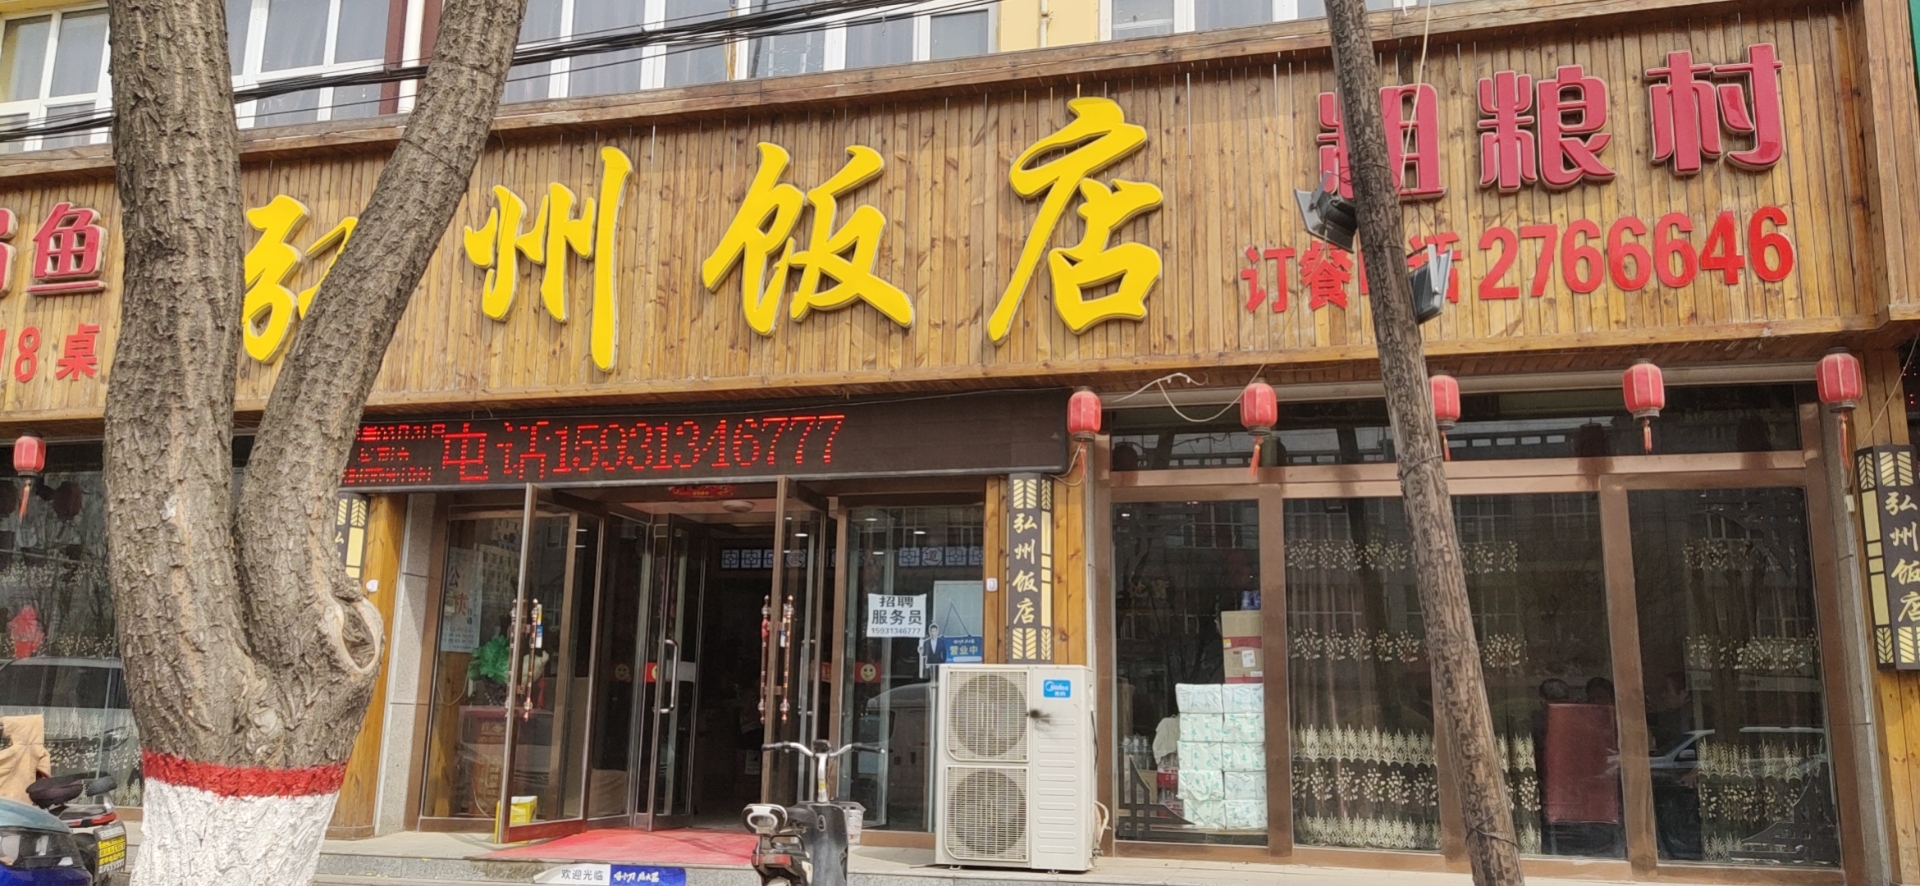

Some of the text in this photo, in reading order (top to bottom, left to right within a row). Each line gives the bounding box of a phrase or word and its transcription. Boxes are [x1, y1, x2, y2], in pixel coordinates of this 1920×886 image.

[1316, 42, 1784, 201] 粗粮村
[243, 96, 1164, 373] 弘州饭店
[1479, 205, 1794, 301] 2766646
[1011, 512, 1039, 626] 弘州饭店
[879, 595, 914, 608] 招聘
[871, 609, 922, 626] 服务员
[871, 627, 922, 635] 15931346777
[949, 645, 979, 656] 营业中
[561, 868, 604, 881] 欢迎光临
